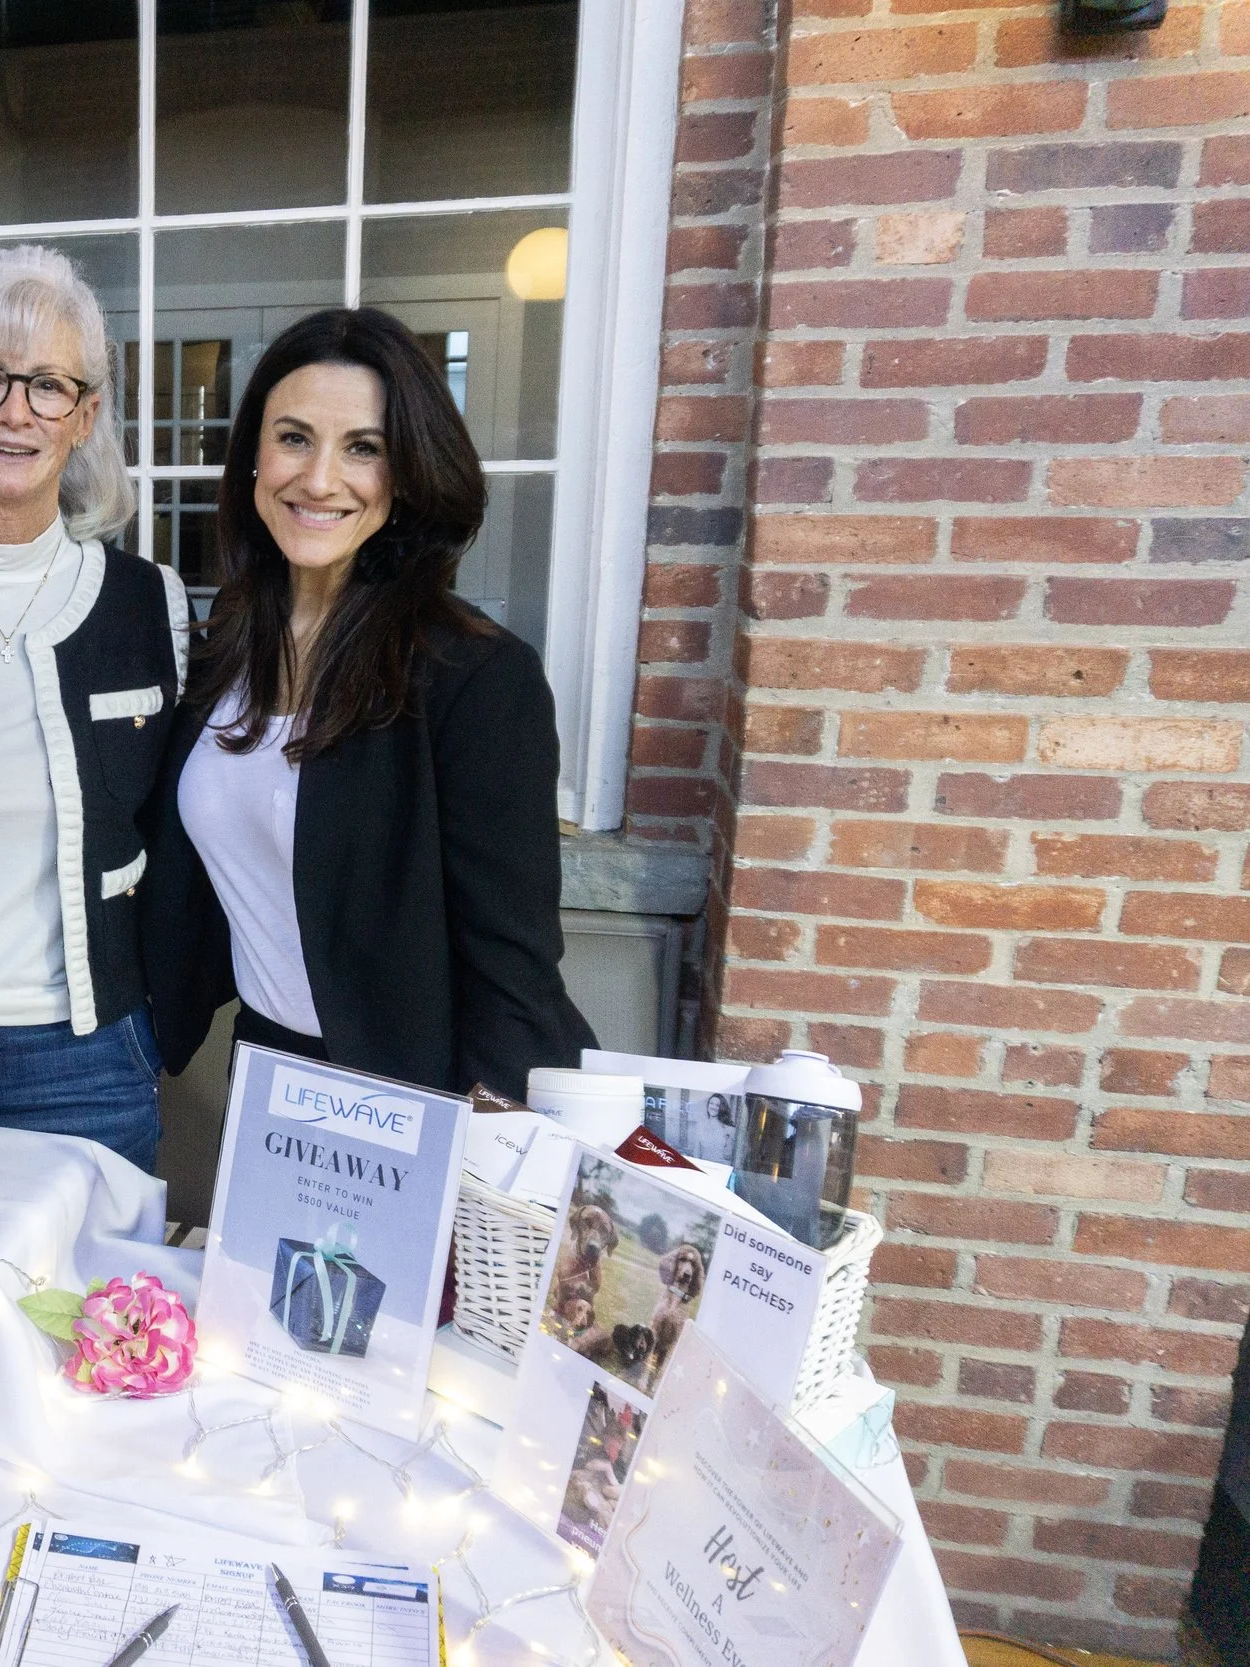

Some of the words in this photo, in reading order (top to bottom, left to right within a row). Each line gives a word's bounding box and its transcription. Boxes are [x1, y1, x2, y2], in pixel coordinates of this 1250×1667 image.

[264, 1132, 409, 1191] GIVEAWAY
[297, 1176, 330, 1193] ENTER
[335, 1188, 348, 1199] TO
[353, 1193, 373, 1206] WIN
[297, 1192, 322, 1208] $500
[326, 1203, 360, 1220] VALUE
[724, 1223, 747, 1243] Did
[749, 1238, 812, 1275] someone
[750, 1262, 773, 1282] say
[723, 1270, 794, 1314] PATCHES?
[214, 1558, 263, 1571] LIFEWAVE
[219, 1569, 255, 1580] SIGNUP
[704, 1525, 764, 1600] Host
[664, 1560, 721, 1645] Wellness
[711, 1593, 724, 1616] A
